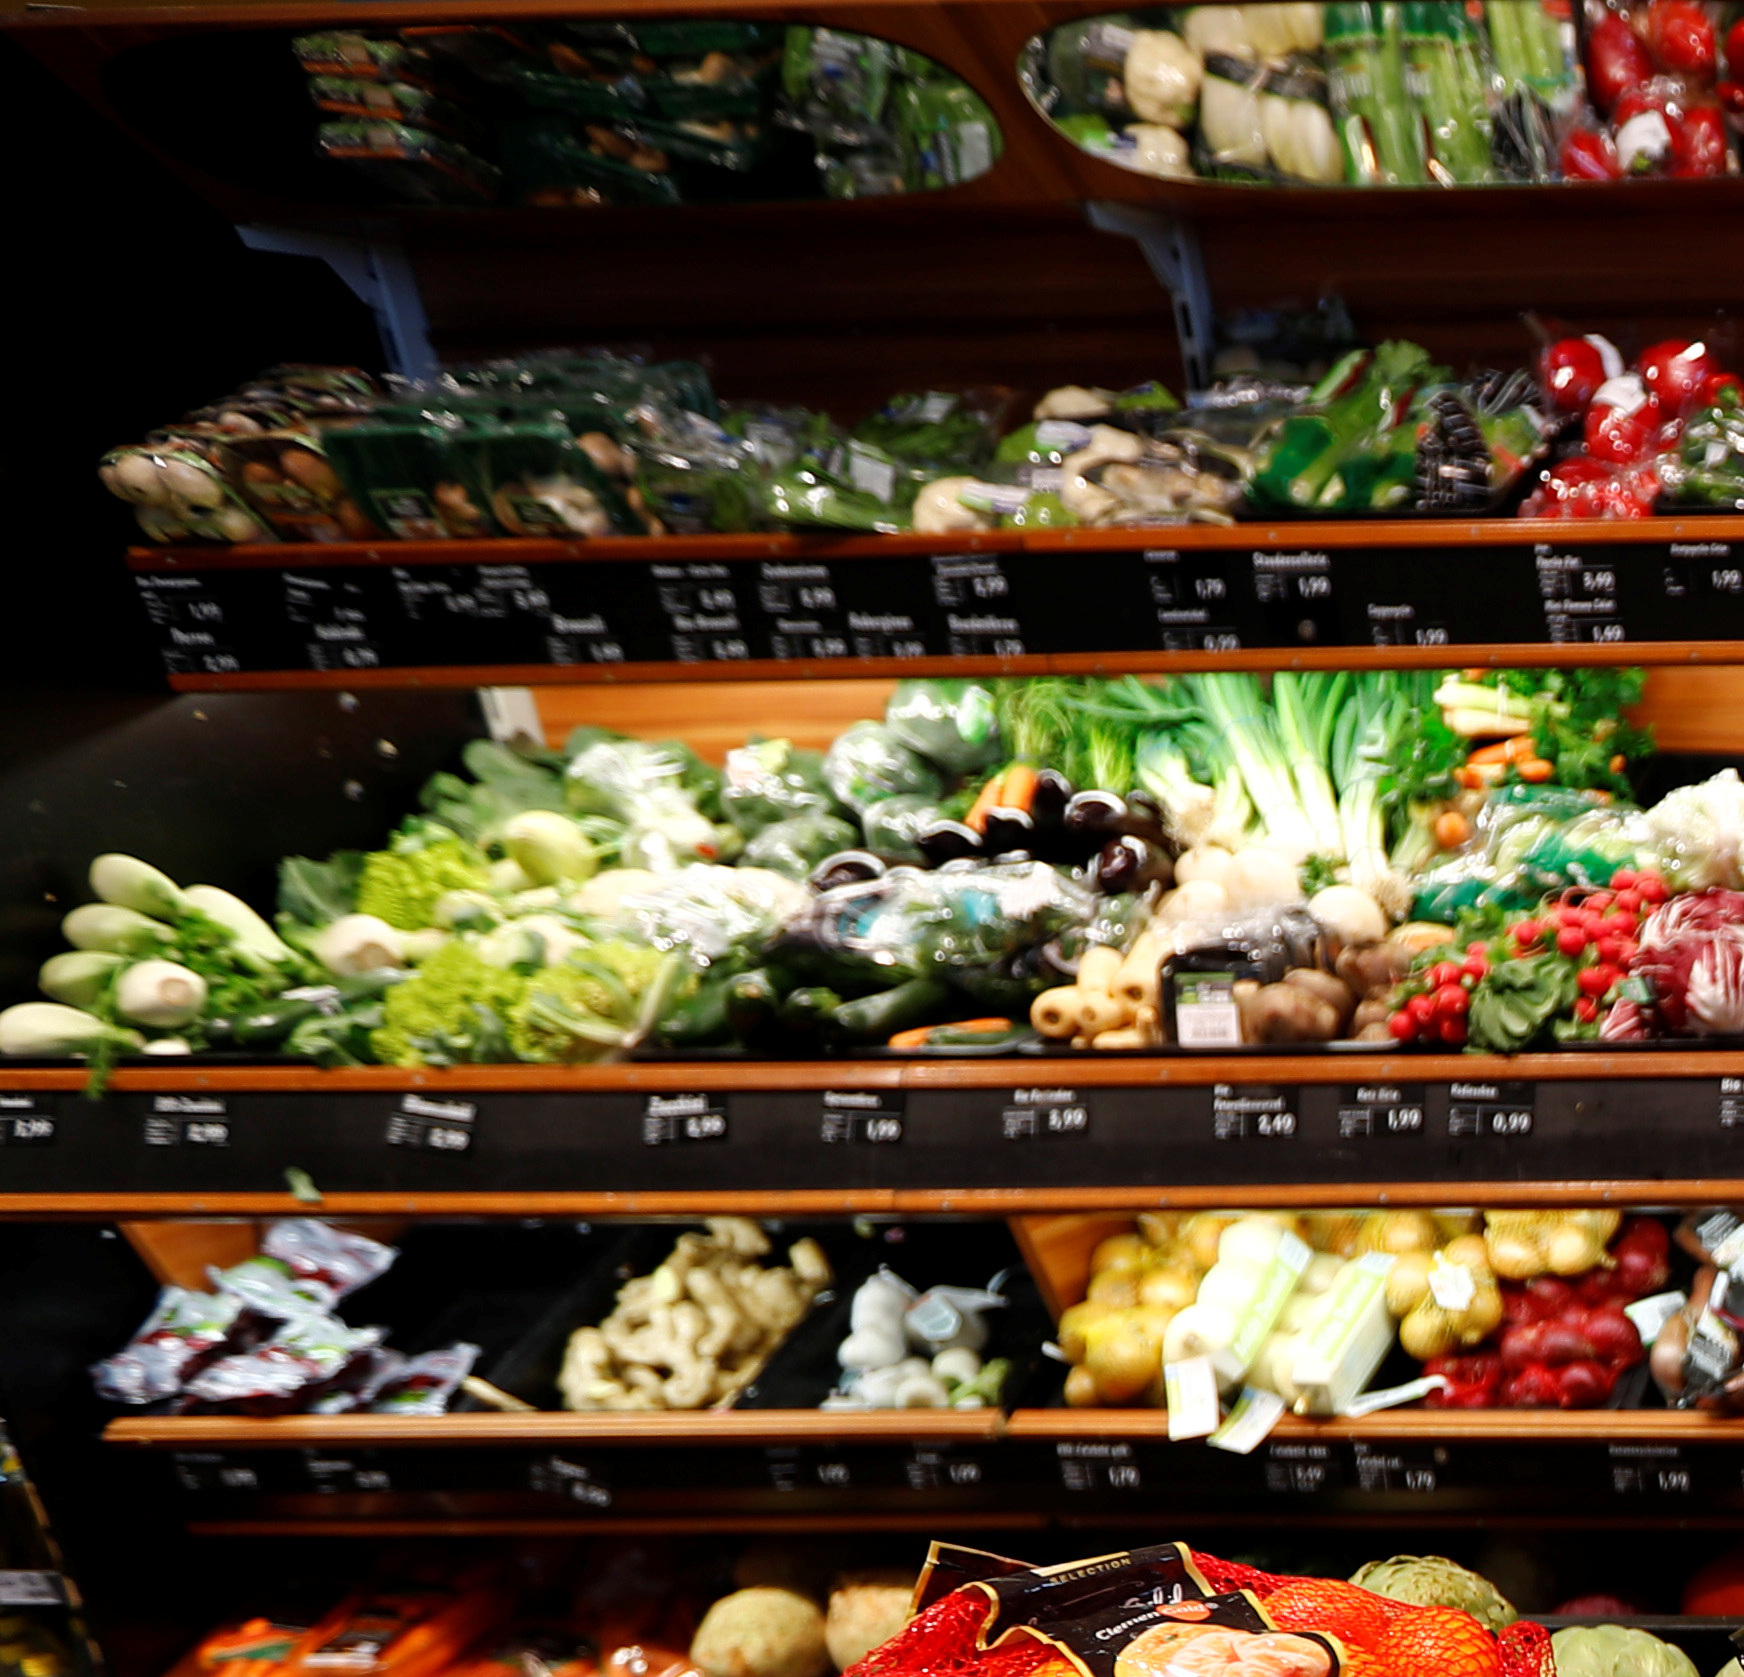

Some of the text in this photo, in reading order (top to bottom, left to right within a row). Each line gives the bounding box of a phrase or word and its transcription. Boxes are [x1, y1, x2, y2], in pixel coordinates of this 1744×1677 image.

[1712, 570, 1742, 588] 1,99
[1721, 1076, 1741, 1092] Bio
[1387, 1107, 1422, 1131] 1,99
[1491, 1110, 1532, 1134] 0,99
[1096, 1600, 1208, 1641] Clemen Gold
